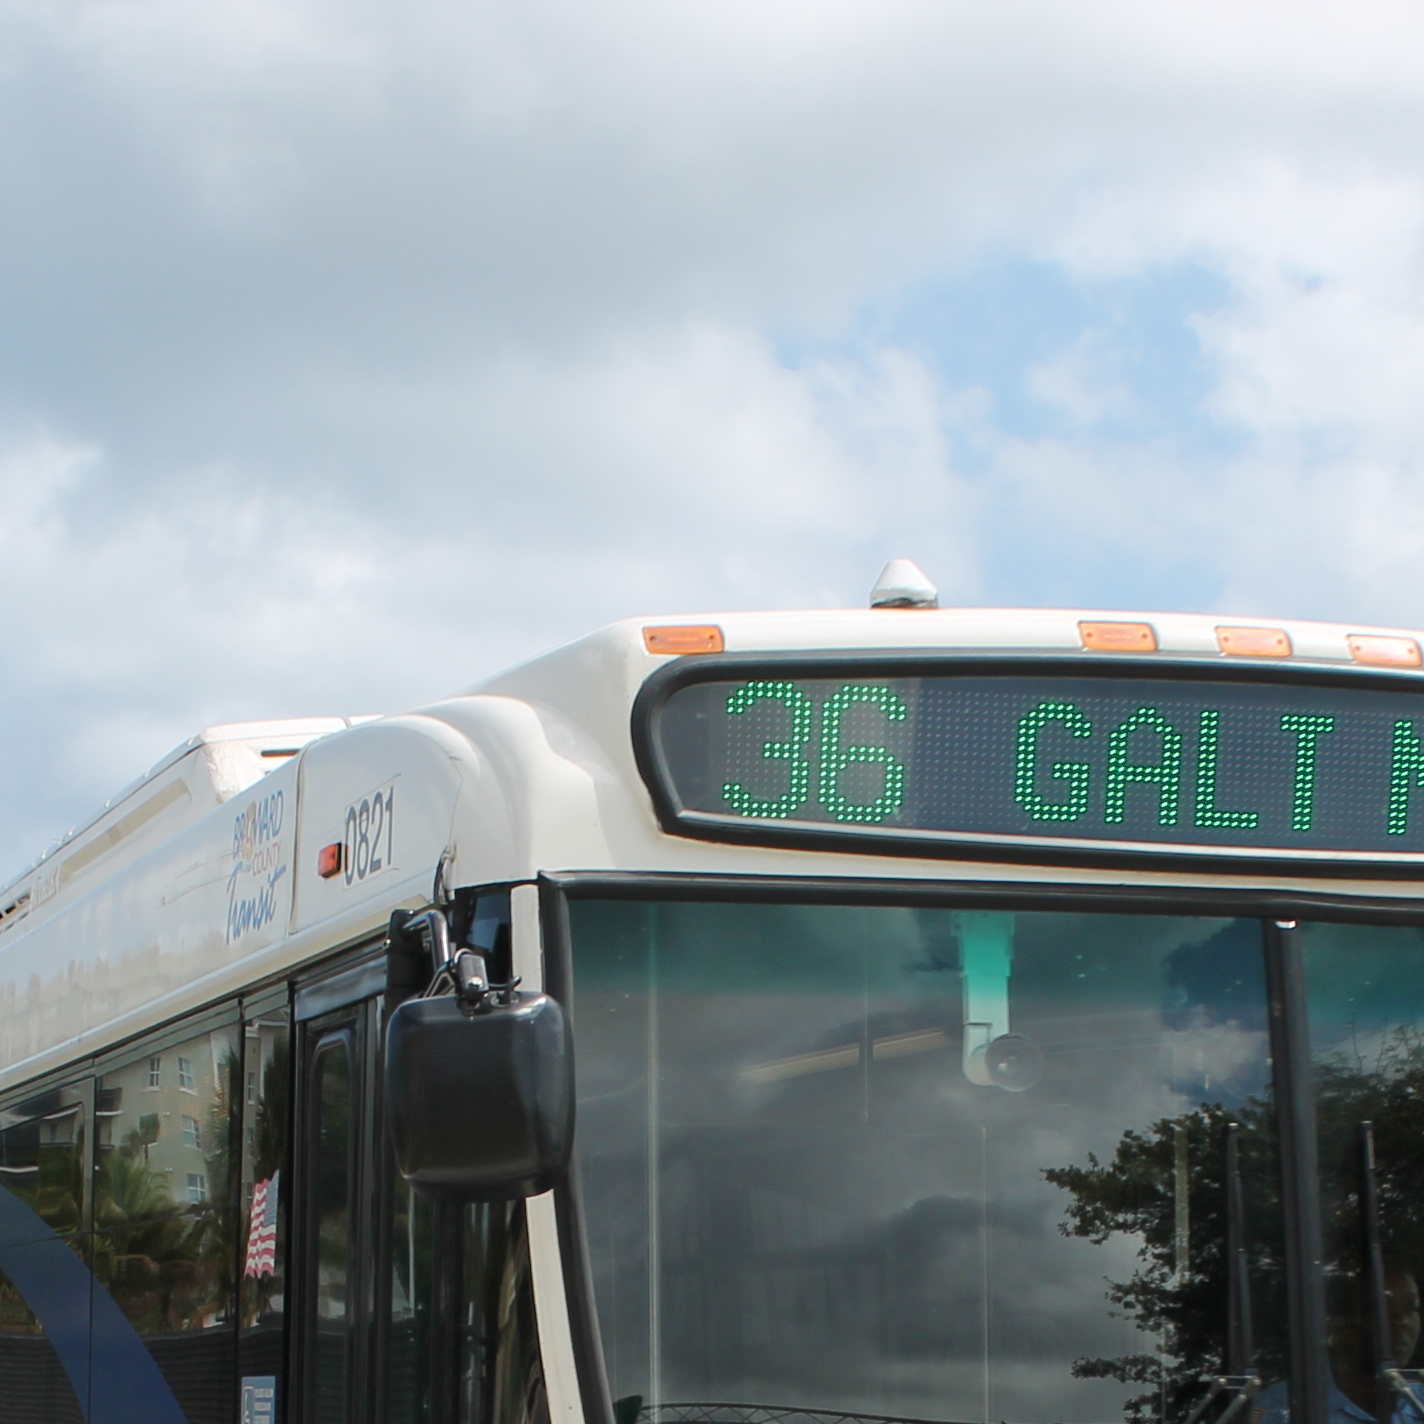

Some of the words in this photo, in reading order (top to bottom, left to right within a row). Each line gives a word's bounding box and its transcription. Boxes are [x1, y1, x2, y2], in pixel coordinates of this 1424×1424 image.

[721, 678, 909, 823] 36
[1012, 701, 1336, 833] GALT
[252, 841, 282, 876] COUNTY
[344, 785, 394, 887] 0821
[226, 864, 287, 946] Transit
